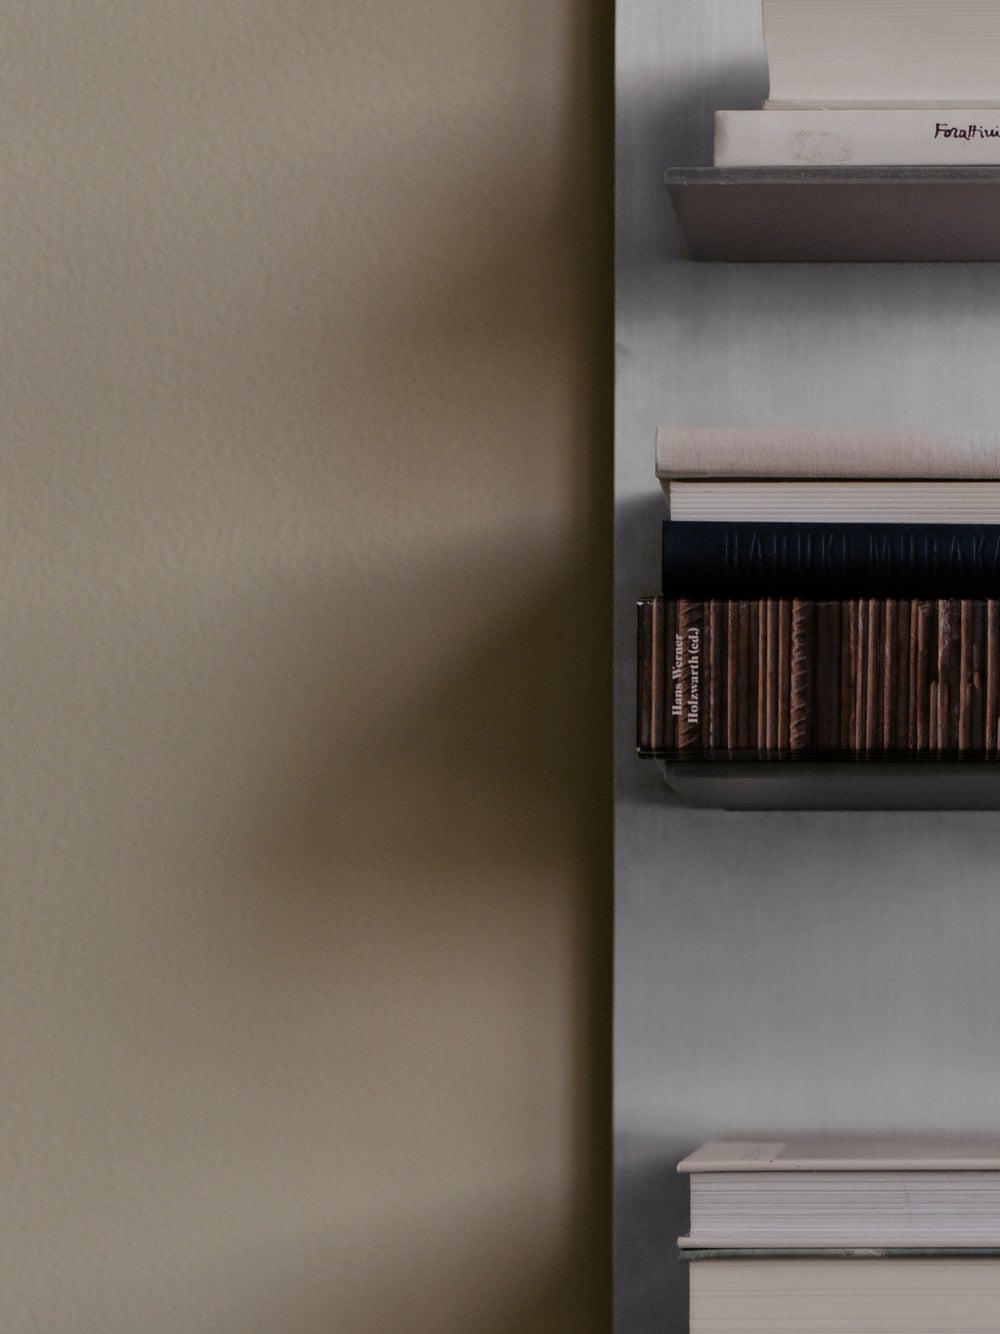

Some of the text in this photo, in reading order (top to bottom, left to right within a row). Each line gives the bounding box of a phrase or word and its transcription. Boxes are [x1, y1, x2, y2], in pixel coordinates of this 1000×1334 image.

[672, 634, 683, 716] Hans Werner
[688, 627, 700, 723] Holzwarth (ed.)
